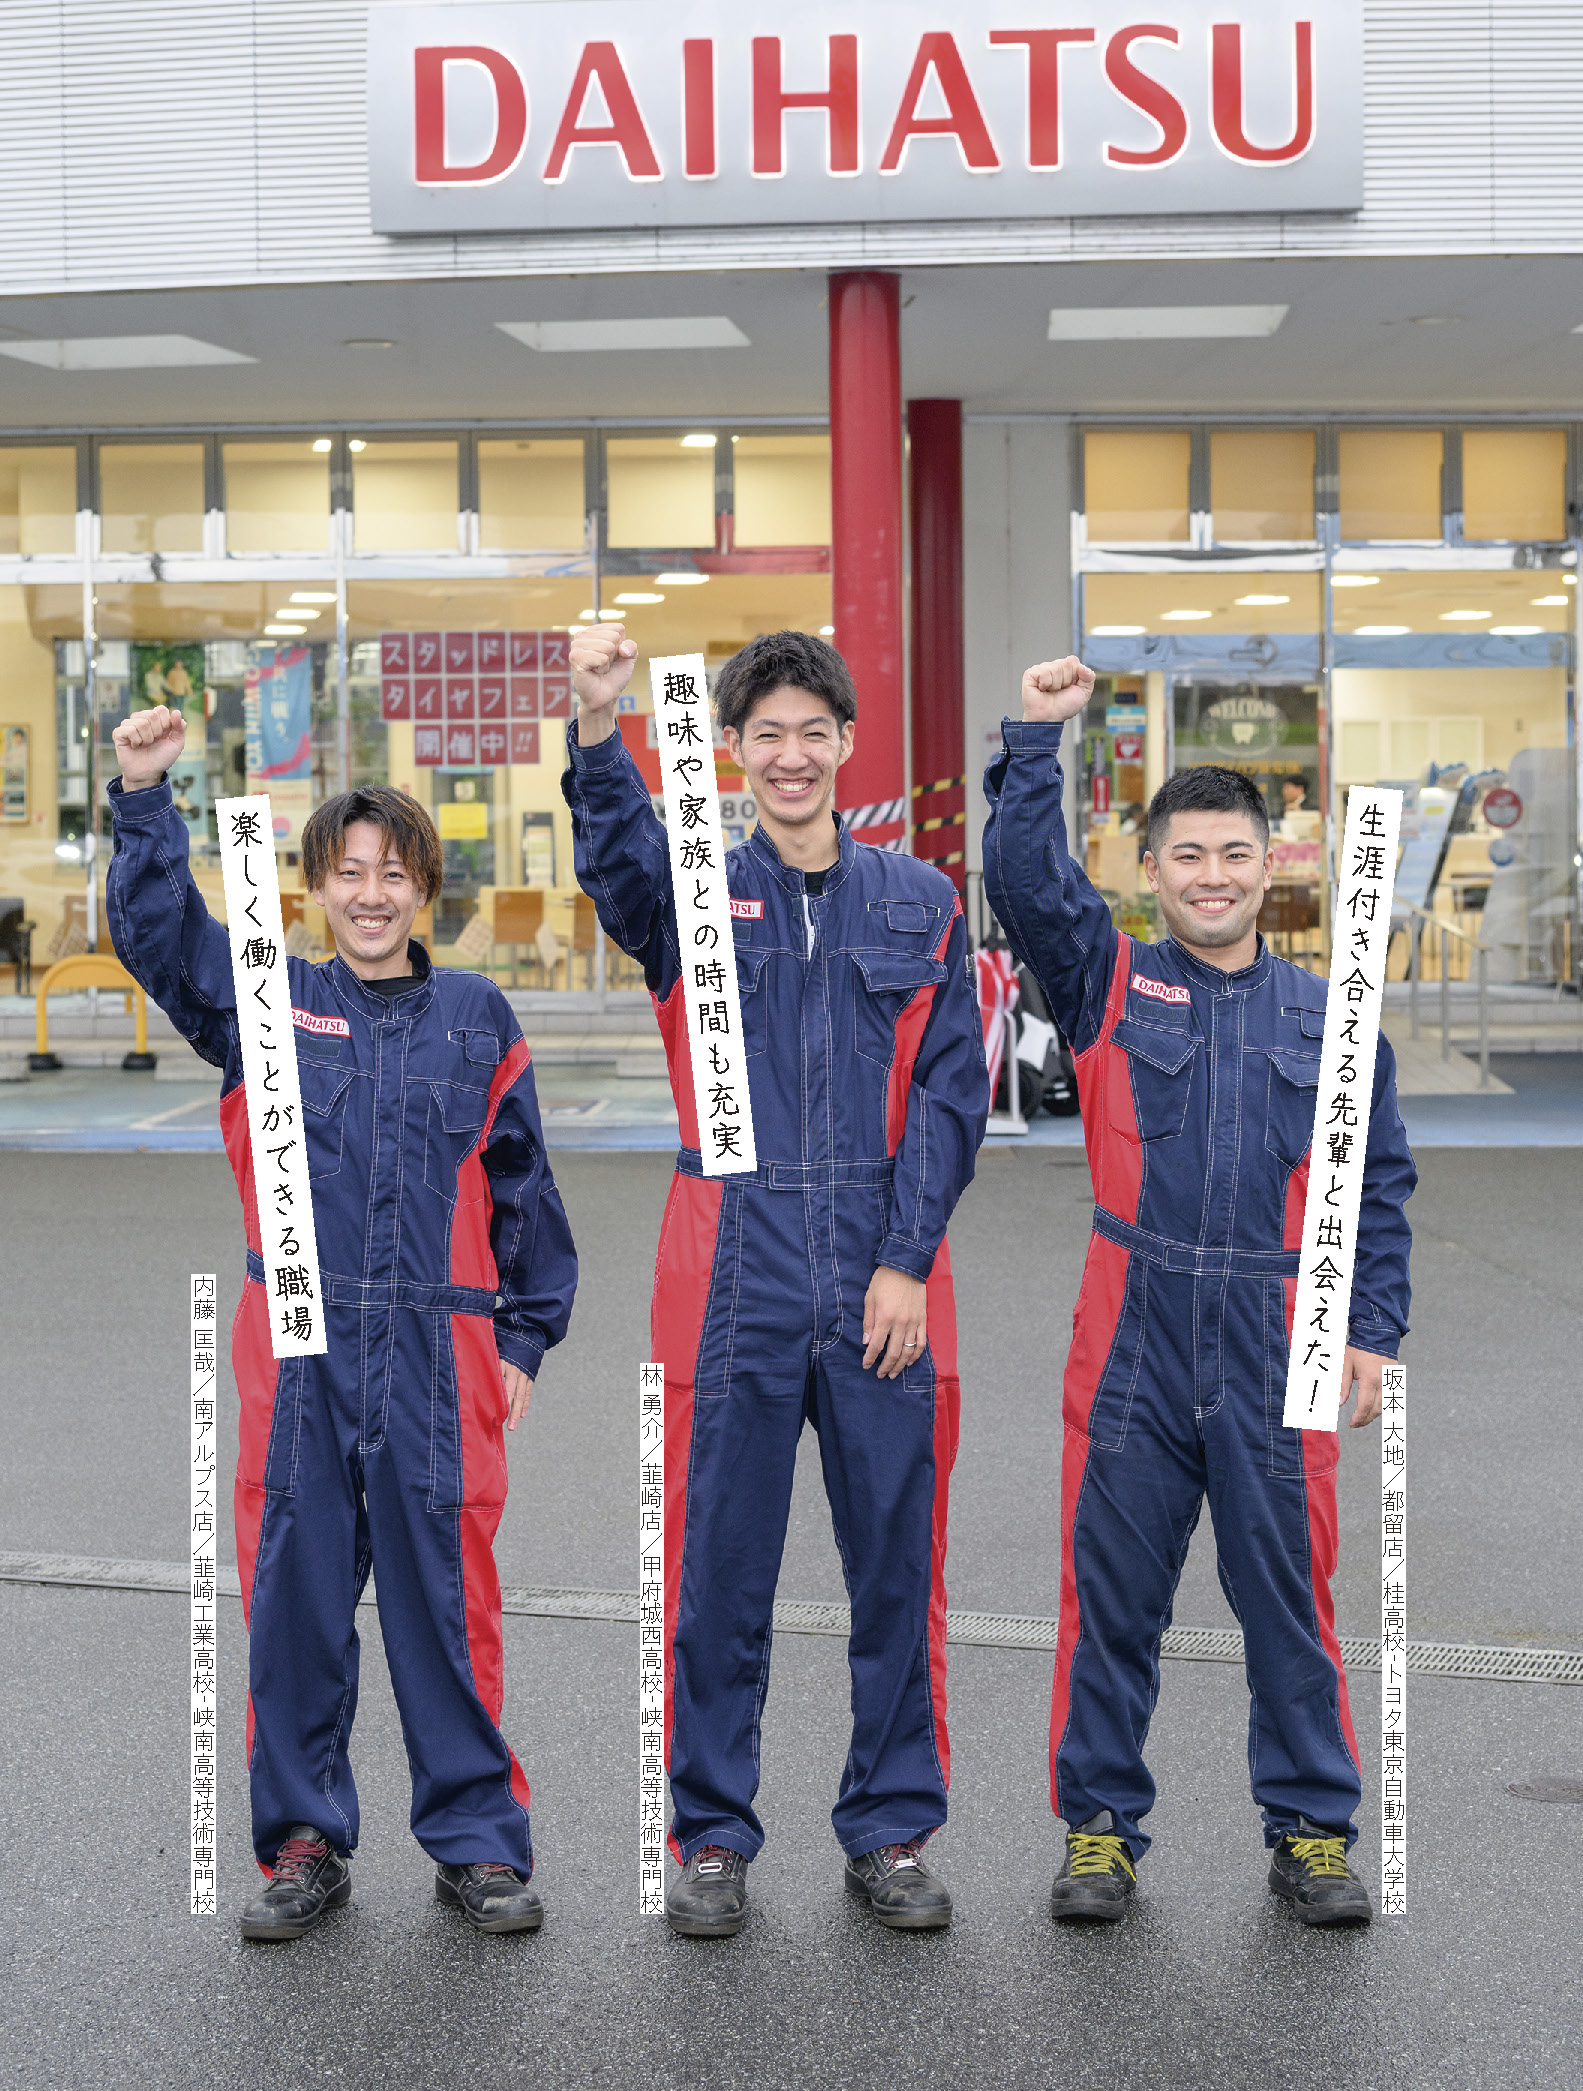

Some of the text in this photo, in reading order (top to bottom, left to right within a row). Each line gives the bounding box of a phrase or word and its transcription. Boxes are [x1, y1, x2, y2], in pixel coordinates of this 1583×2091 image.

[413, 20, 1314, 185] DAIHATSU
[384, 640, 567, 667] スタッドレス
[386, 685, 568, 713] タイヤフェア
[414, 729, 533, 758] 開催中!!
